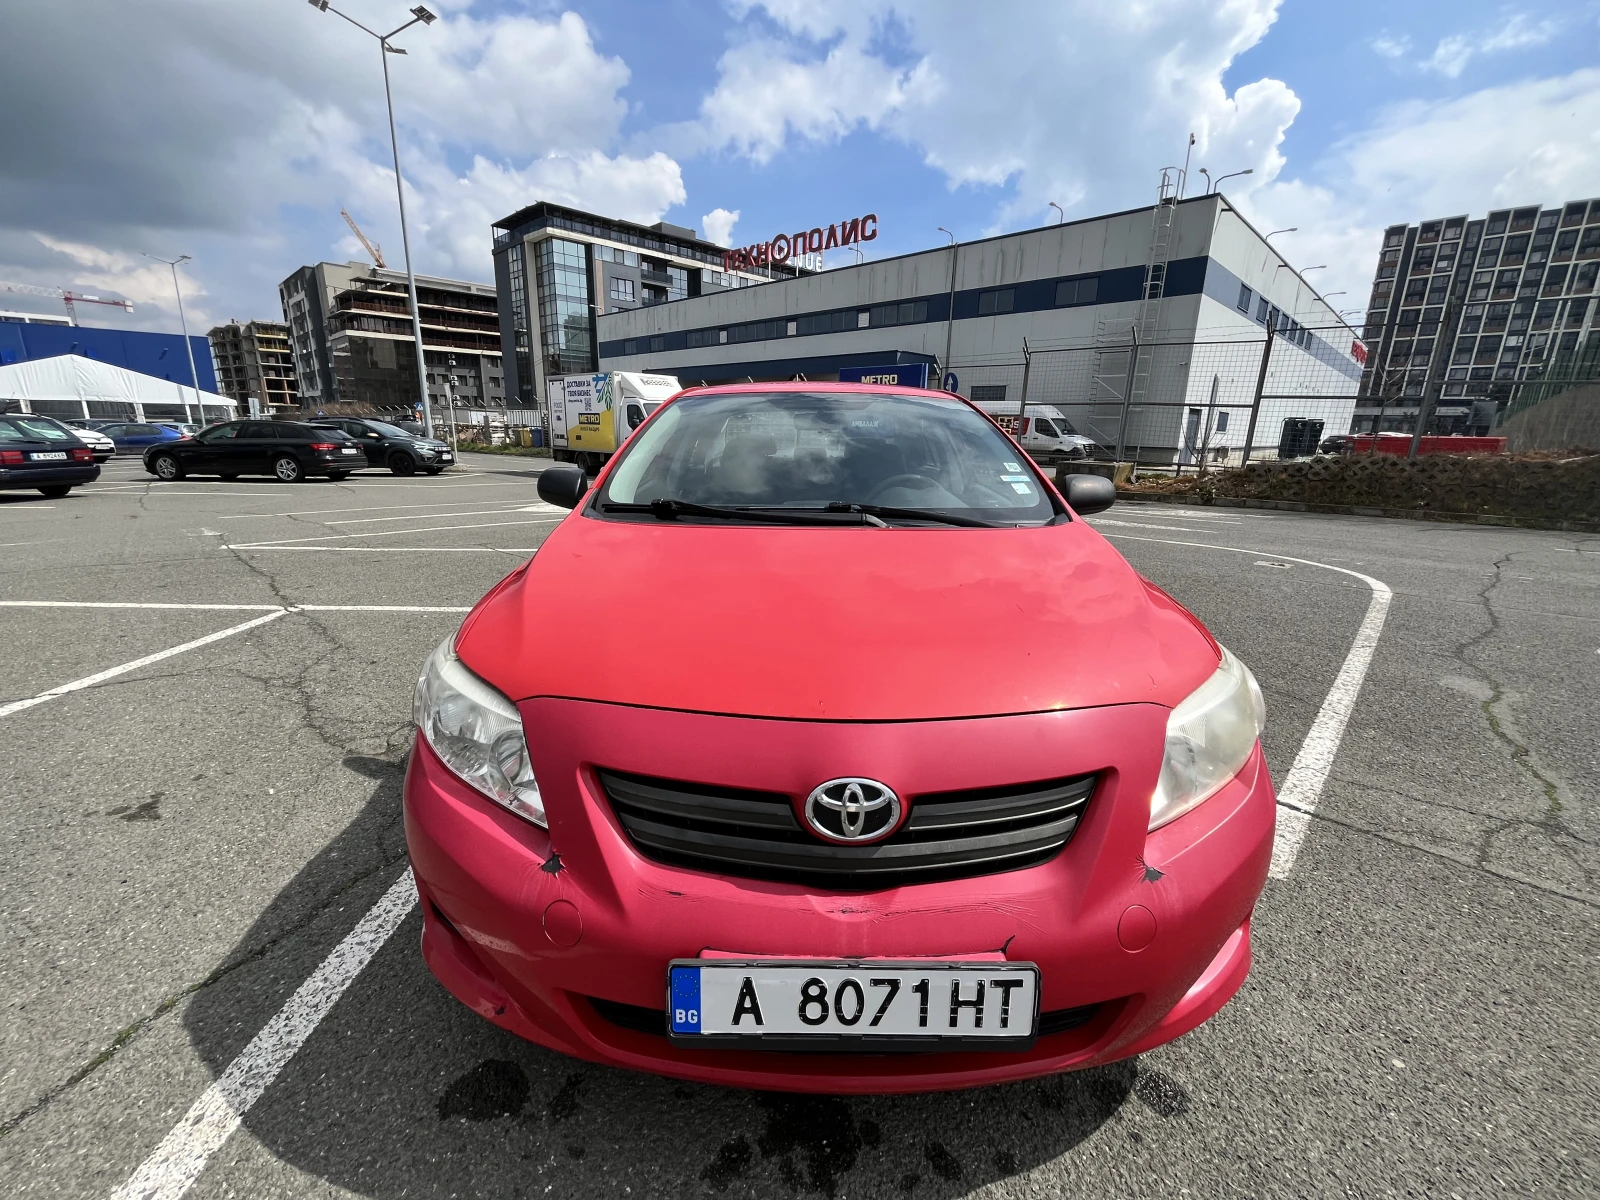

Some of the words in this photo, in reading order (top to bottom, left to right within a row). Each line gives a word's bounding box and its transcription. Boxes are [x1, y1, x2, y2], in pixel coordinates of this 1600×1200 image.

[721, 213, 878, 272] ТЕХНОПОЛИС
[785, 253, 822, 272] NUE
[861, 374, 898, 385] METRO
[579, 414, 600, 423] METRO
[731, 976, 765, 1026] A
[675, 1008, 698, 1024] BG
